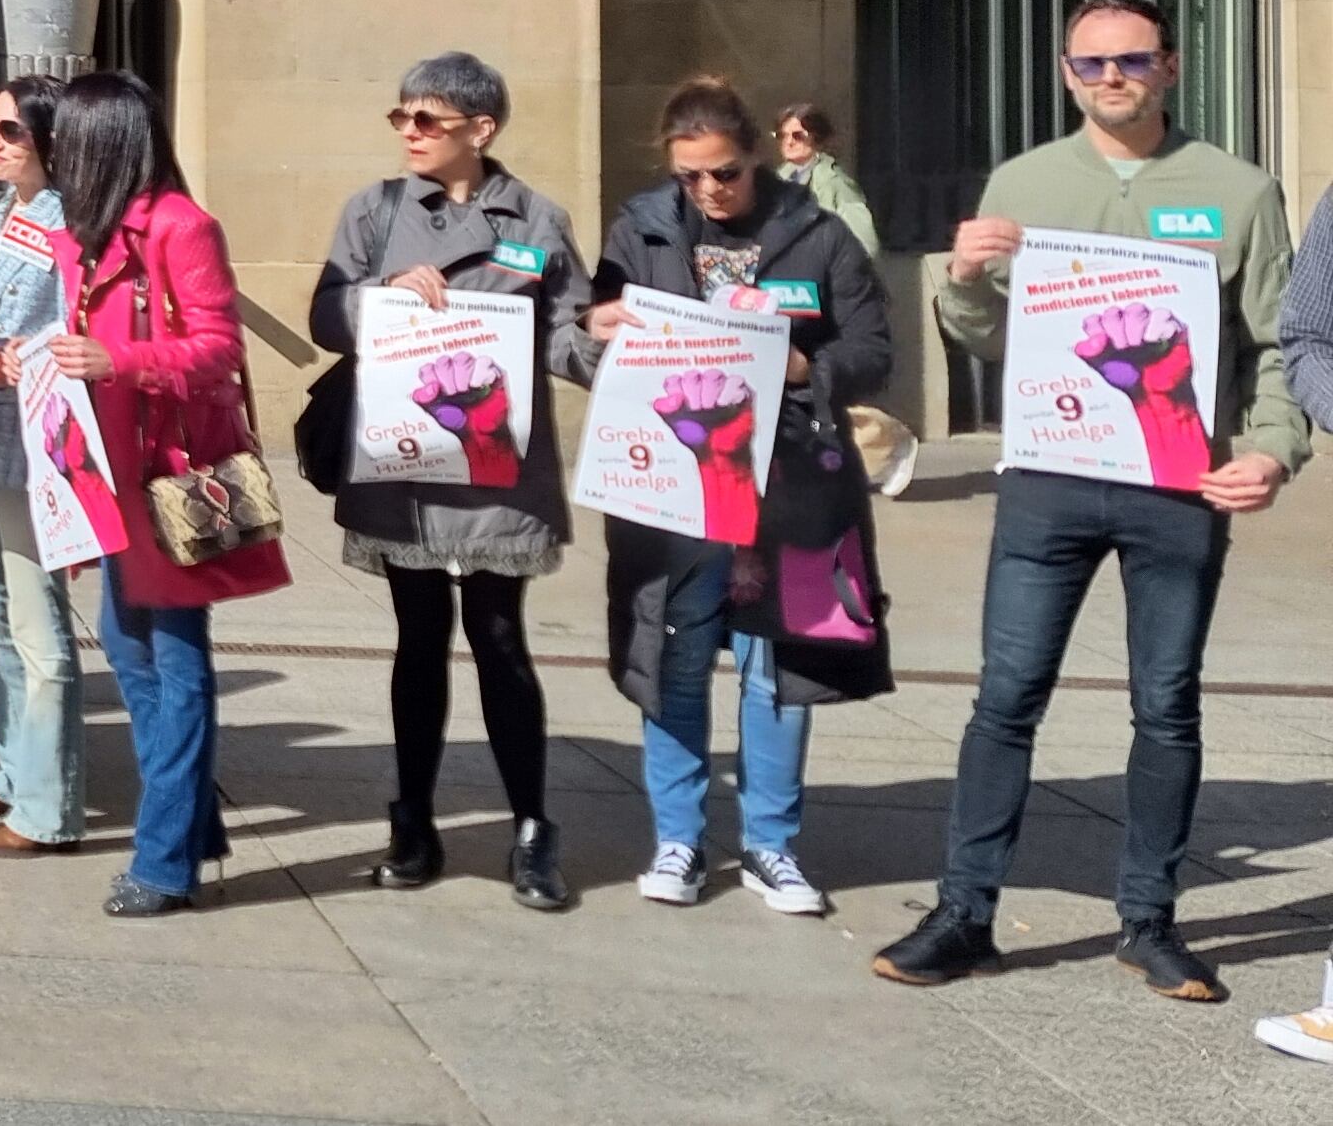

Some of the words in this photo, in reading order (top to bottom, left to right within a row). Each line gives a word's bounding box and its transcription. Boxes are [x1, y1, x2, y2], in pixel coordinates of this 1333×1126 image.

[1158, 214, 1213, 233] ELA
[1027, 281, 1075, 296] Mejora
[1080, 275, 1095, 289] de
[1099, 268, 1161, 284] nuestras
[1024, 292, 1110, 314] condiciones
[1112, 283, 1180, 300] laborales
[432, 317, 484, 337] nuestras
[443, 332, 499, 352] laborales
[666, 337, 681, 348] de
[685, 336, 741, 347] nuestras
[616, 356, 691, 367] condiciones
[694, 352, 755, 364] laborales
[1018, 375, 1093, 396] Greba
[1056, 394, 1082, 421] 9
[366, 421, 428, 442] Greba
[598, 426, 665, 443] Greba
[1032, 422, 1115, 443] Huelga
[398, 438, 420, 460] 9
[629, 444, 651, 470] 9
[376, 457, 446, 474] Huelga
[604, 472, 677, 494] Huelga
